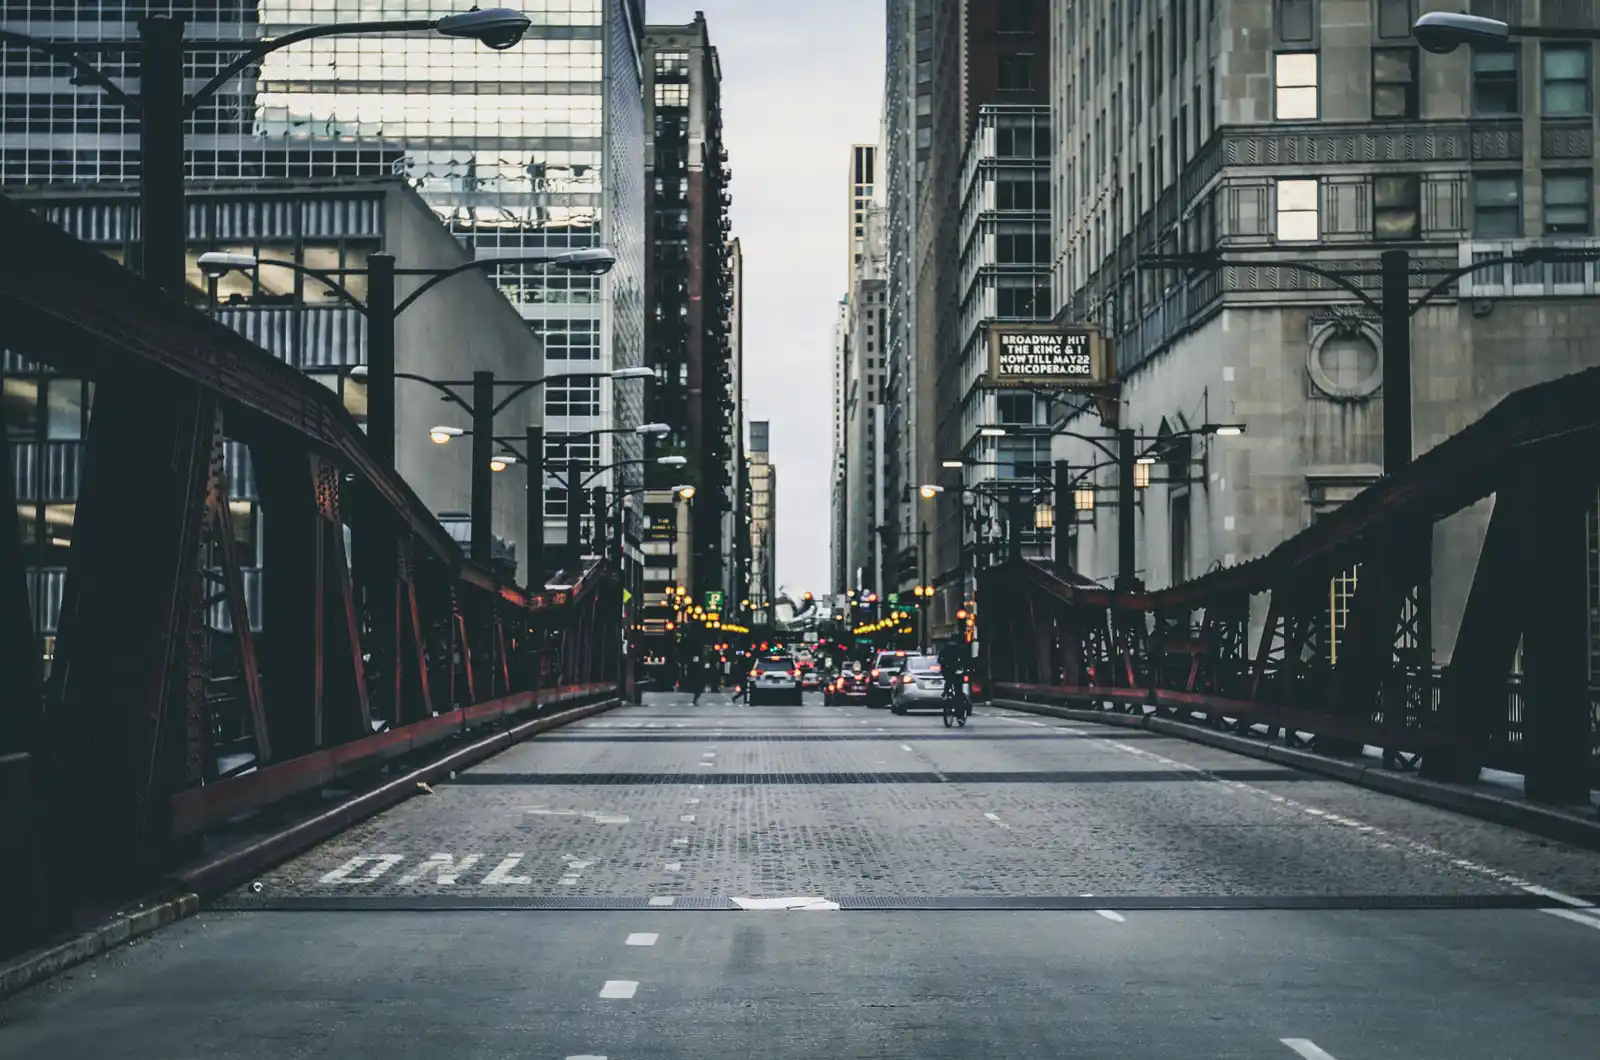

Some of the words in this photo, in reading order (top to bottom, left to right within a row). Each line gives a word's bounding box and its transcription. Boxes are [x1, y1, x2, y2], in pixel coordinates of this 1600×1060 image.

[1002, 335, 1063, 344] BROADWAY
[1067, 335, 1086, 344] HIT
[1007, 345, 1029, 354] THE
[1033, 345, 1061, 354] KING
[1064, 345, 1073, 354] &
[1000, 355, 1026, 364] NOW
[1027, 355, 1051, 364] TILL
[1000, 365, 1090, 374] LYRICOPERA.ORG
[318, 853, 600, 885] ONLY
